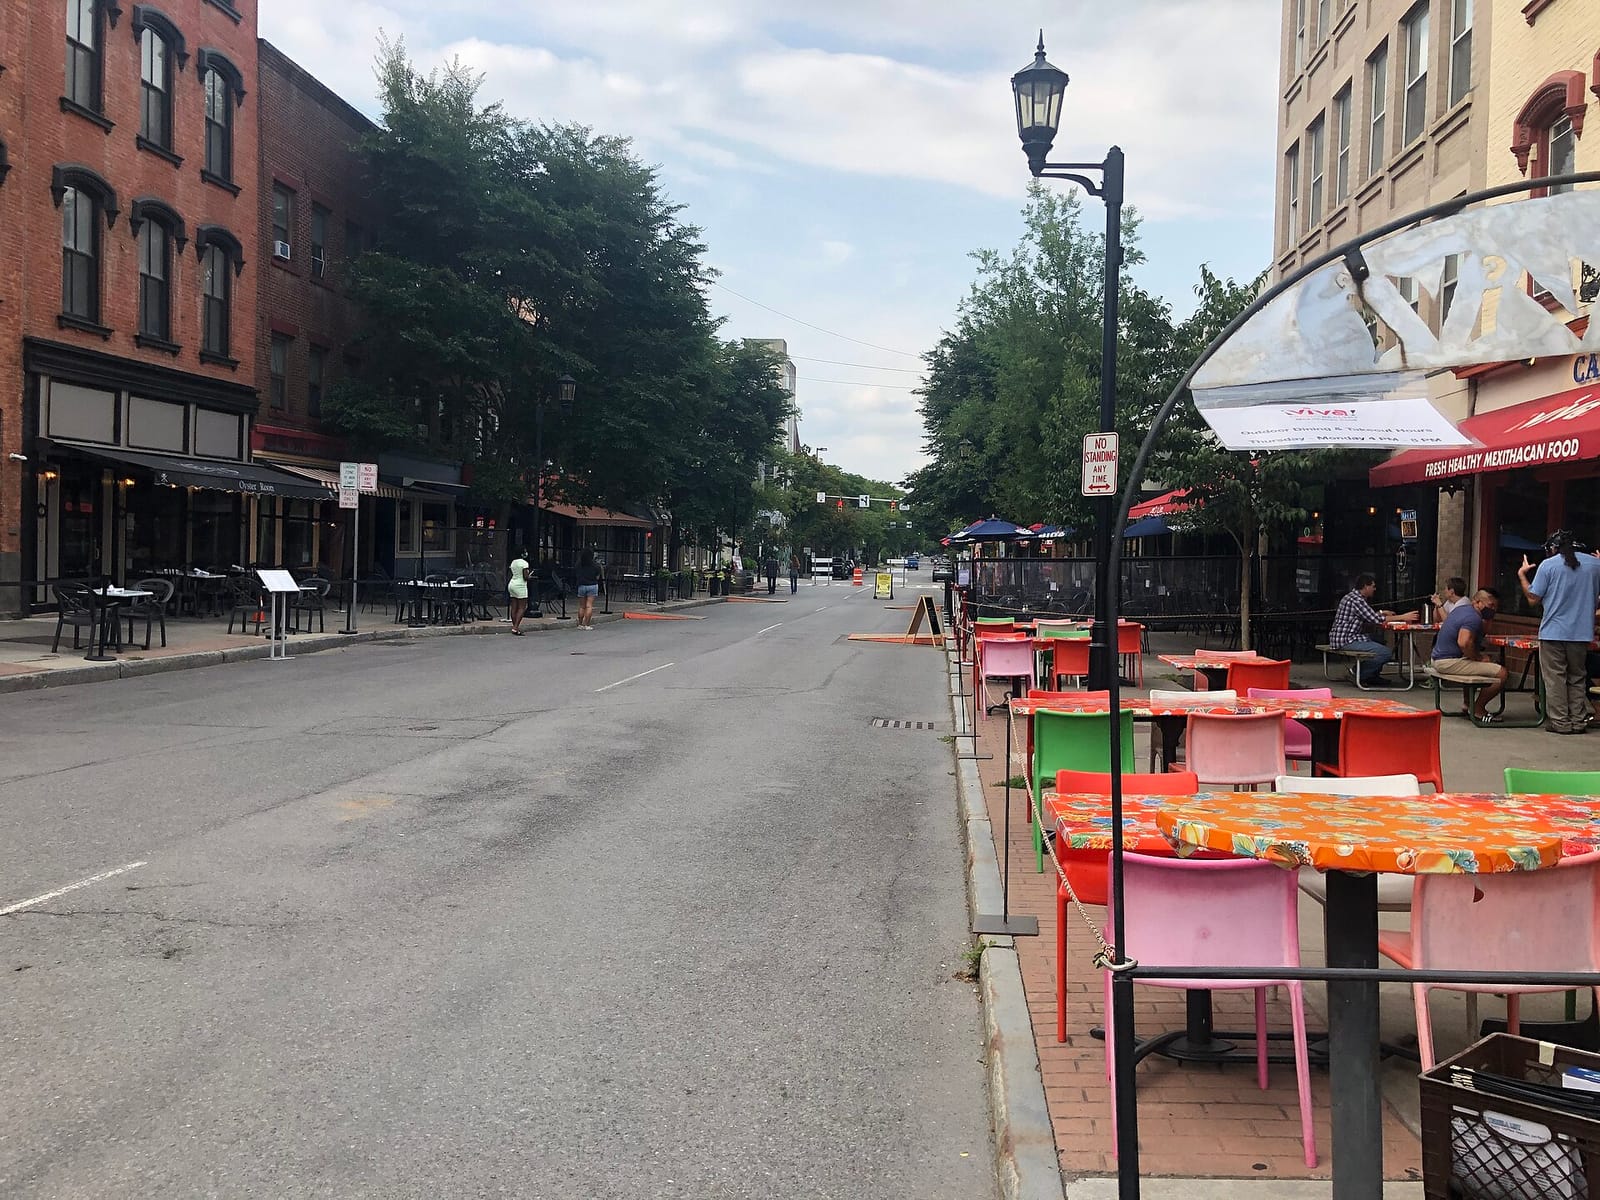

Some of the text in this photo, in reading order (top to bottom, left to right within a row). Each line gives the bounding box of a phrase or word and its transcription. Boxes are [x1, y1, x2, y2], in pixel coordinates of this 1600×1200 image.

[1240, 427, 1290, 435] Outdoor
[1094, 438, 1107, 449] NO
[1248, 436, 1305, 444] Thursday
[1085, 450, 1116, 463] STANDING
[1424, 438, 1580, 477] FRESH HEALTHY MEXITHACAN FOOD
[1093, 465, 1107, 473] ANY
[1092, 474, 1107, 483] TIME
[239, 480, 275, 492] Oyster Room
